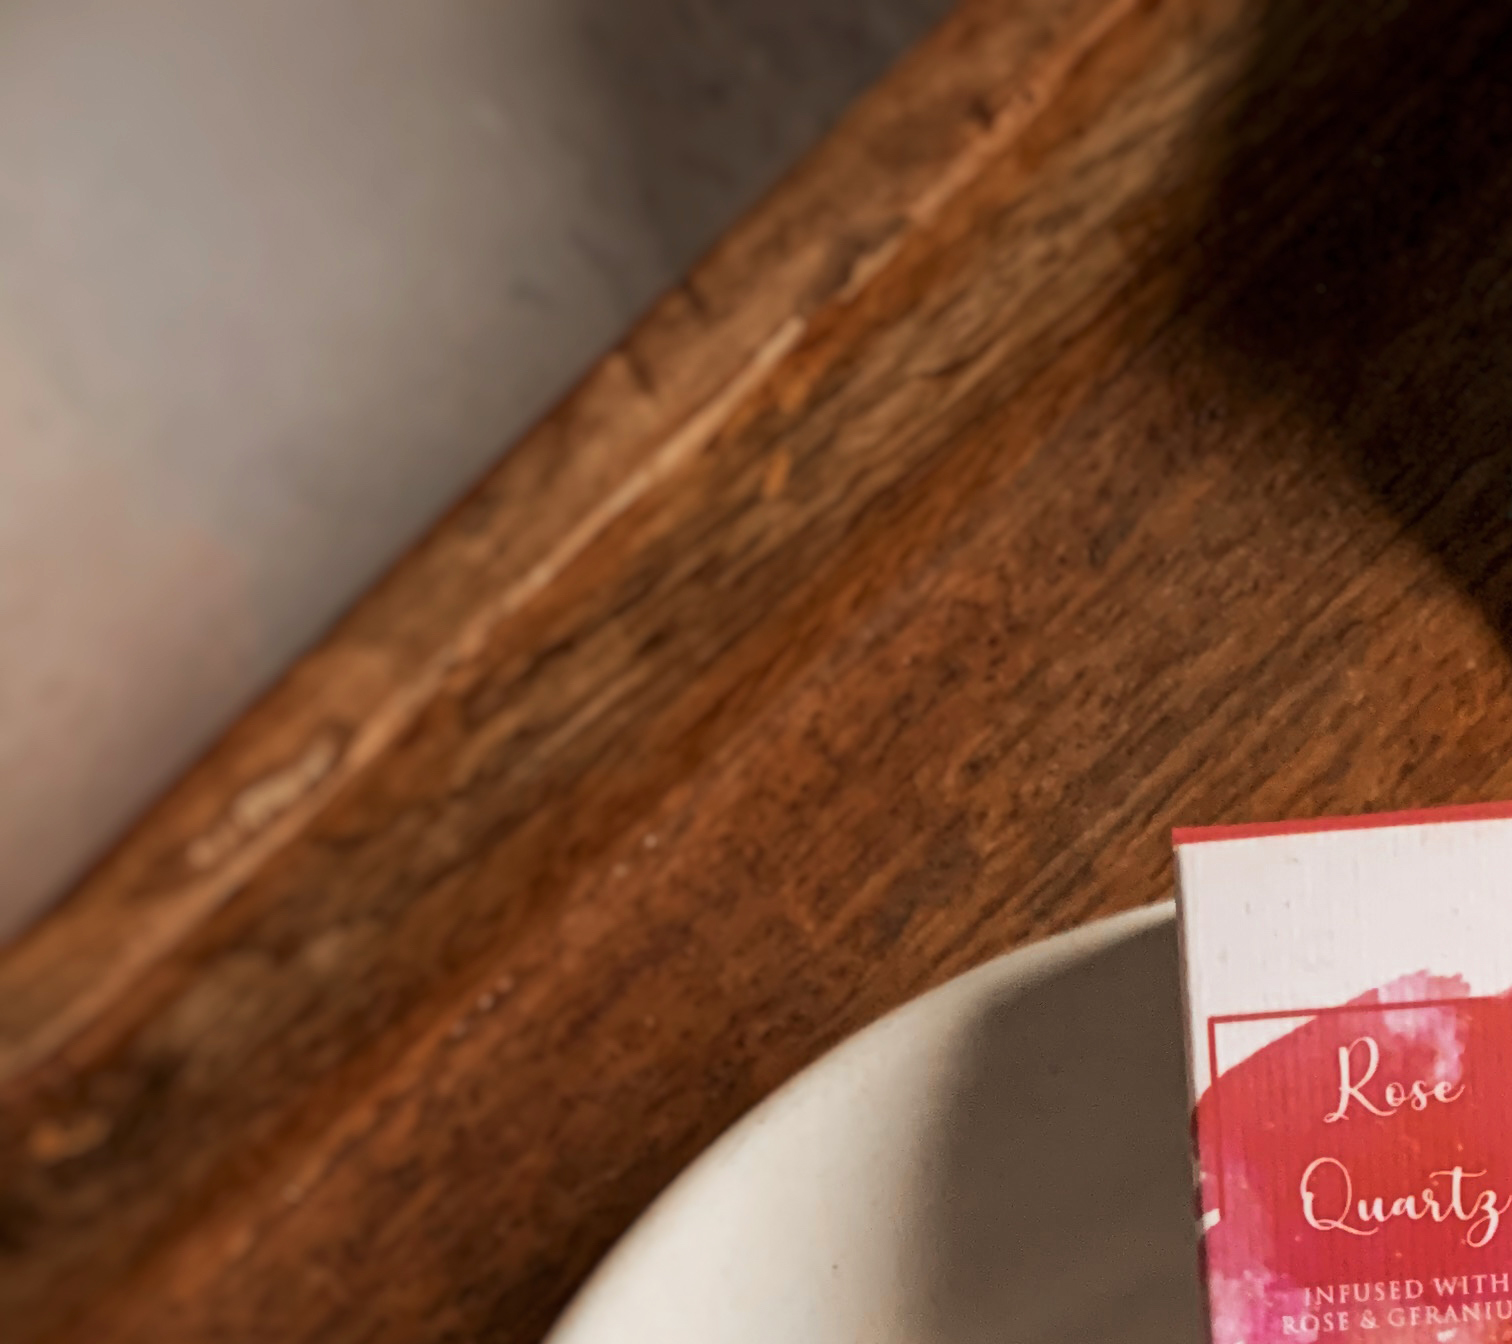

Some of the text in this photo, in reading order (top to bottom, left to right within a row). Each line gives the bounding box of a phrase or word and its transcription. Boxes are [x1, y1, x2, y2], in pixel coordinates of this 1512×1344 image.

[1323, 1036, 1465, 1123] Rose
[1300, 1157, 1512, 1248] Quartz
[1304, 1273, 1510, 1306] INFUSED WITH
[1282, 1309, 1351, 1335] ROSE
[1360, 1309, 1378, 1330] &
